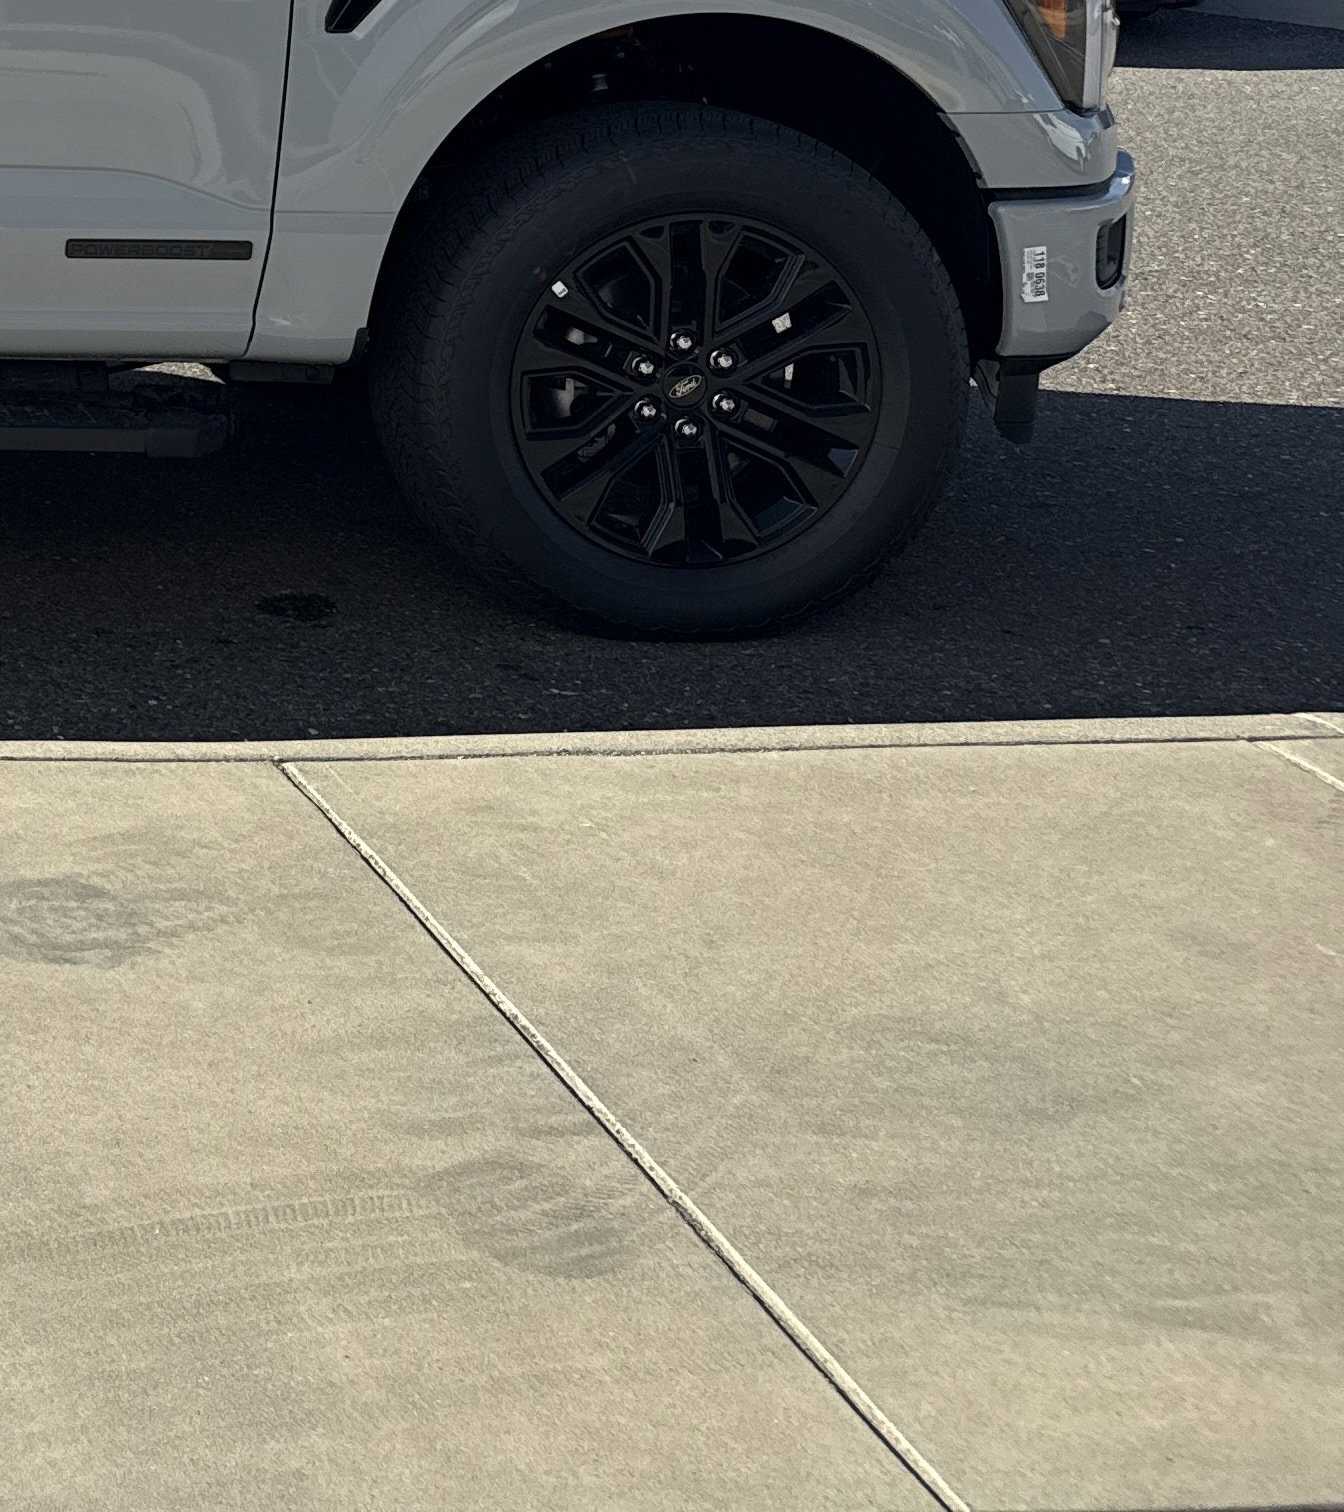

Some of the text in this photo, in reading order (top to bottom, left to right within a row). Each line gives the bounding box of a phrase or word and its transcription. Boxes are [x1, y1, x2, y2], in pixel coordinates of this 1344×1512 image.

[70, 243, 210, 257] POWERBOOST
[1034, 251, 1046, 297] 118 0638
[675, 377, 697, 396] Ford
